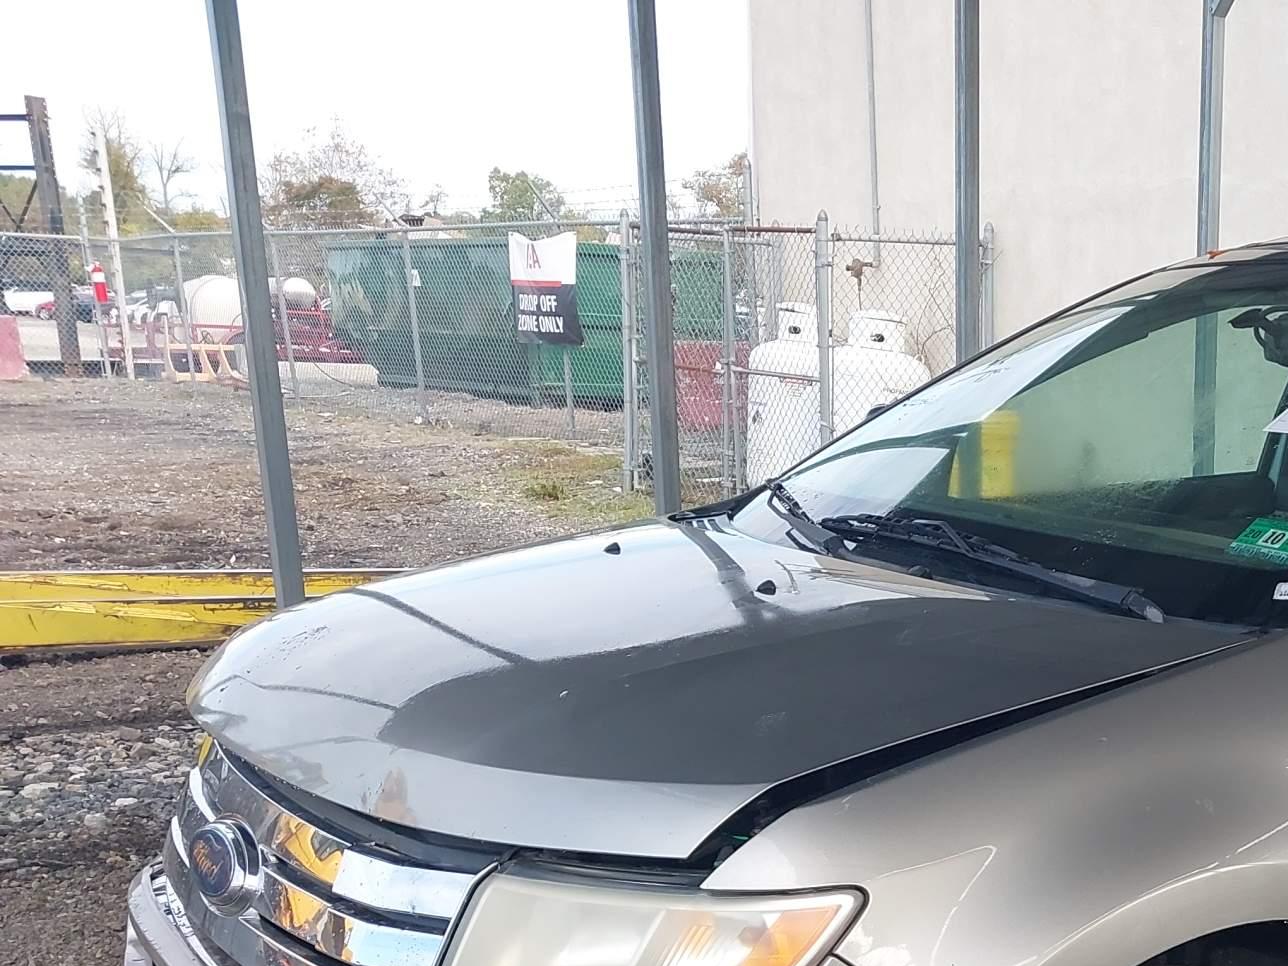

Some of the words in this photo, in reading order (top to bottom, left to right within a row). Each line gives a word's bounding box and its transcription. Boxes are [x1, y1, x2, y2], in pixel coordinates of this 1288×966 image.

[518, 293, 538, 311] DROP
[539, 294, 558, 313] OFF
[517, 314, 539, 332] ZONE
[538, 315, 564, 334] ONLY
[1263, 531, 1286, 545] 10
